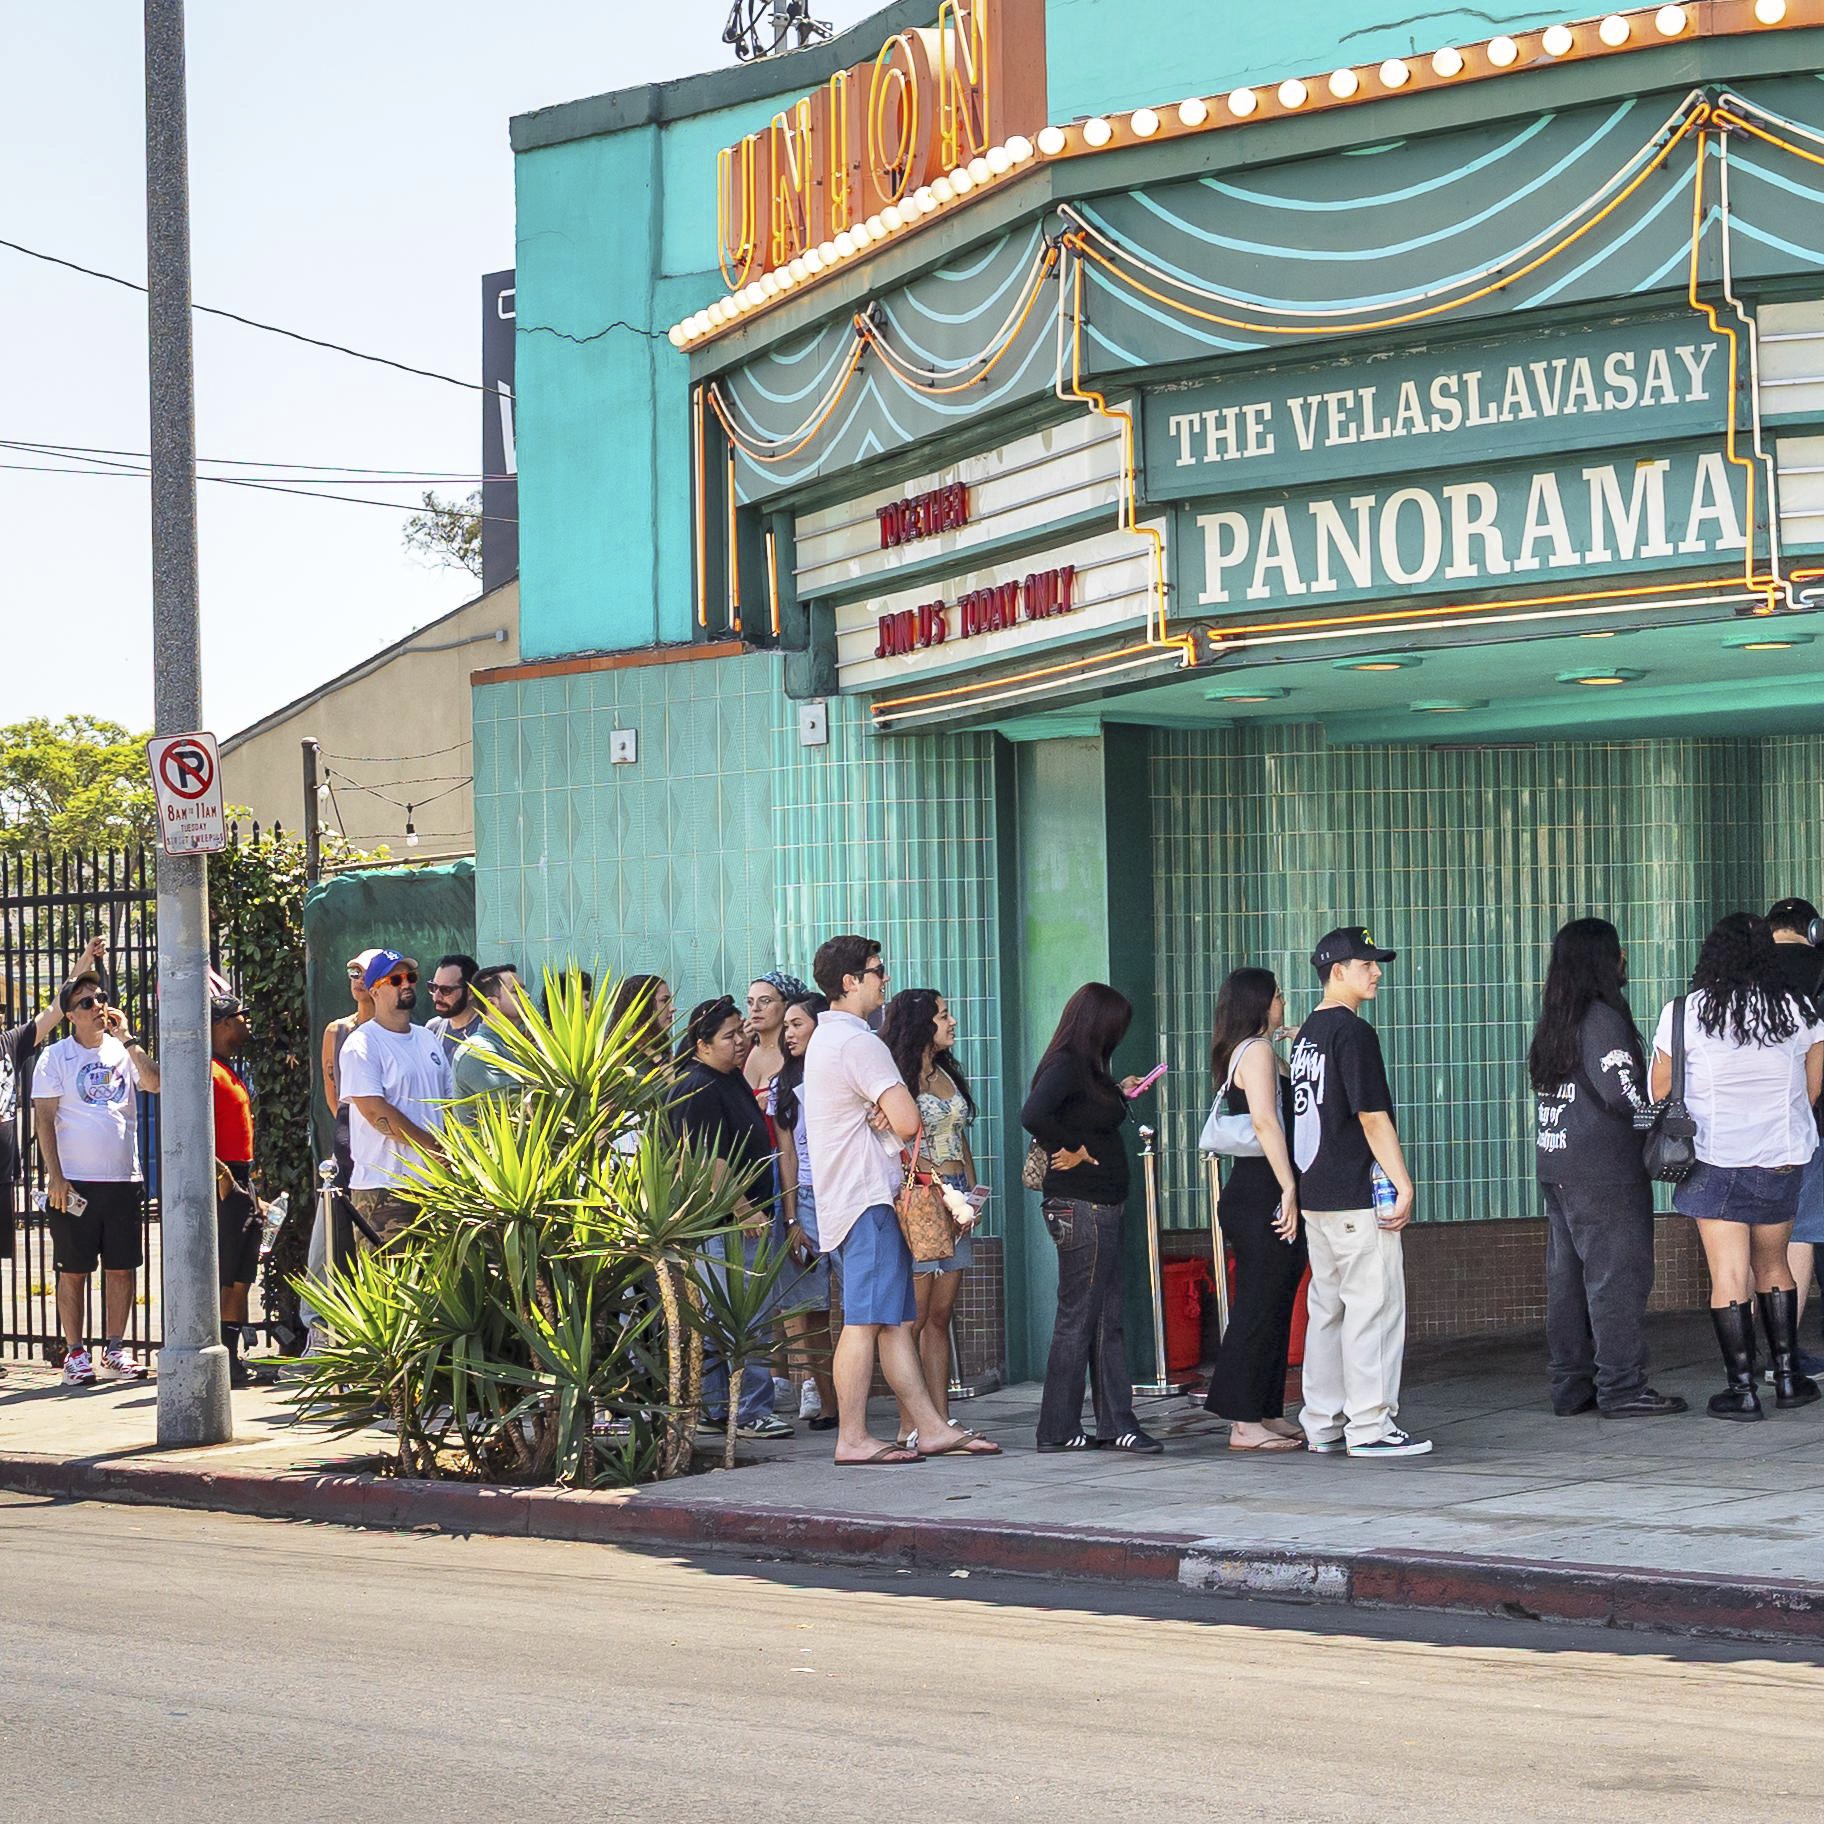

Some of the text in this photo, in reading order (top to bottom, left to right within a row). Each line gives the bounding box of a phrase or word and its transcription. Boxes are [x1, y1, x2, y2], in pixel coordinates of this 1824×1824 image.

[1169, 342, 1718, 467] THE VELASLAVASAY
[876, 481, 969, 549] TOGETHER
[1195, 452, 1748, 605] PANORAMA
[918, 600, 945, 648] US
[957, 580, 1019, 638] TODAY
[1025, 564, 1075, 620] ONLY
[168, 804, 187, 821] 8AM
[196, 802, 217, 819] 11AM
